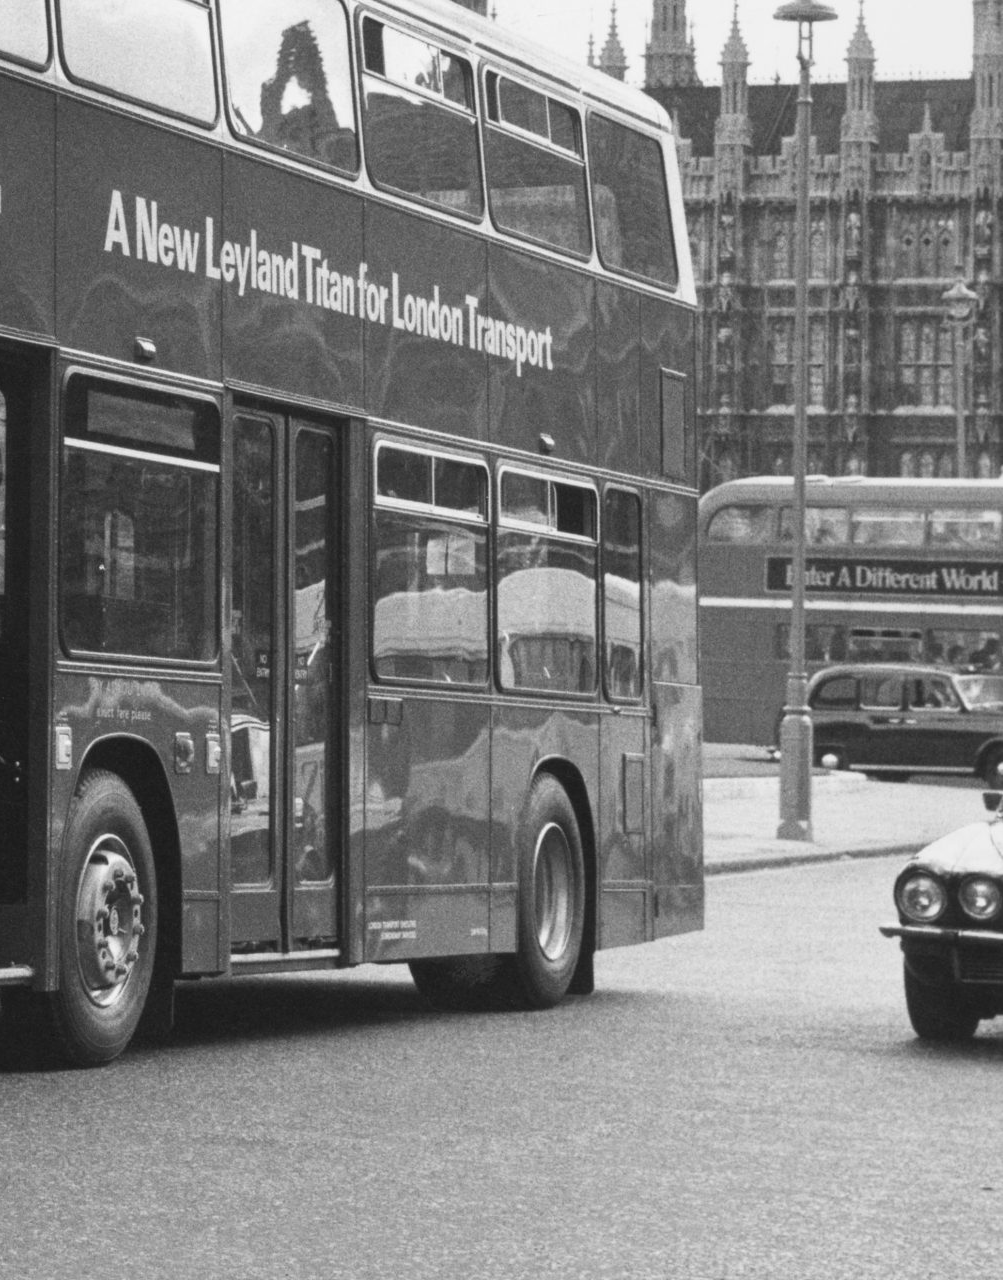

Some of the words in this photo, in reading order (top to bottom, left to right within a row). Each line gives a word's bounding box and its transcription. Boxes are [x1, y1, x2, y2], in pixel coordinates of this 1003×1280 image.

[104, 190, 130, 257] A
[136, 196, 200, 273] New
[206, 217, 298, 300] Leyland
[301, 245, 354, 316] Titan
[358, 263, 388, 324] for
[392, 272, 463, 345] London
[465, 295, 553, 377] Transport
[836, 566, 851, 588] A
[856, 566, 937, 590] Different
[941, 567, 999, 592] World
